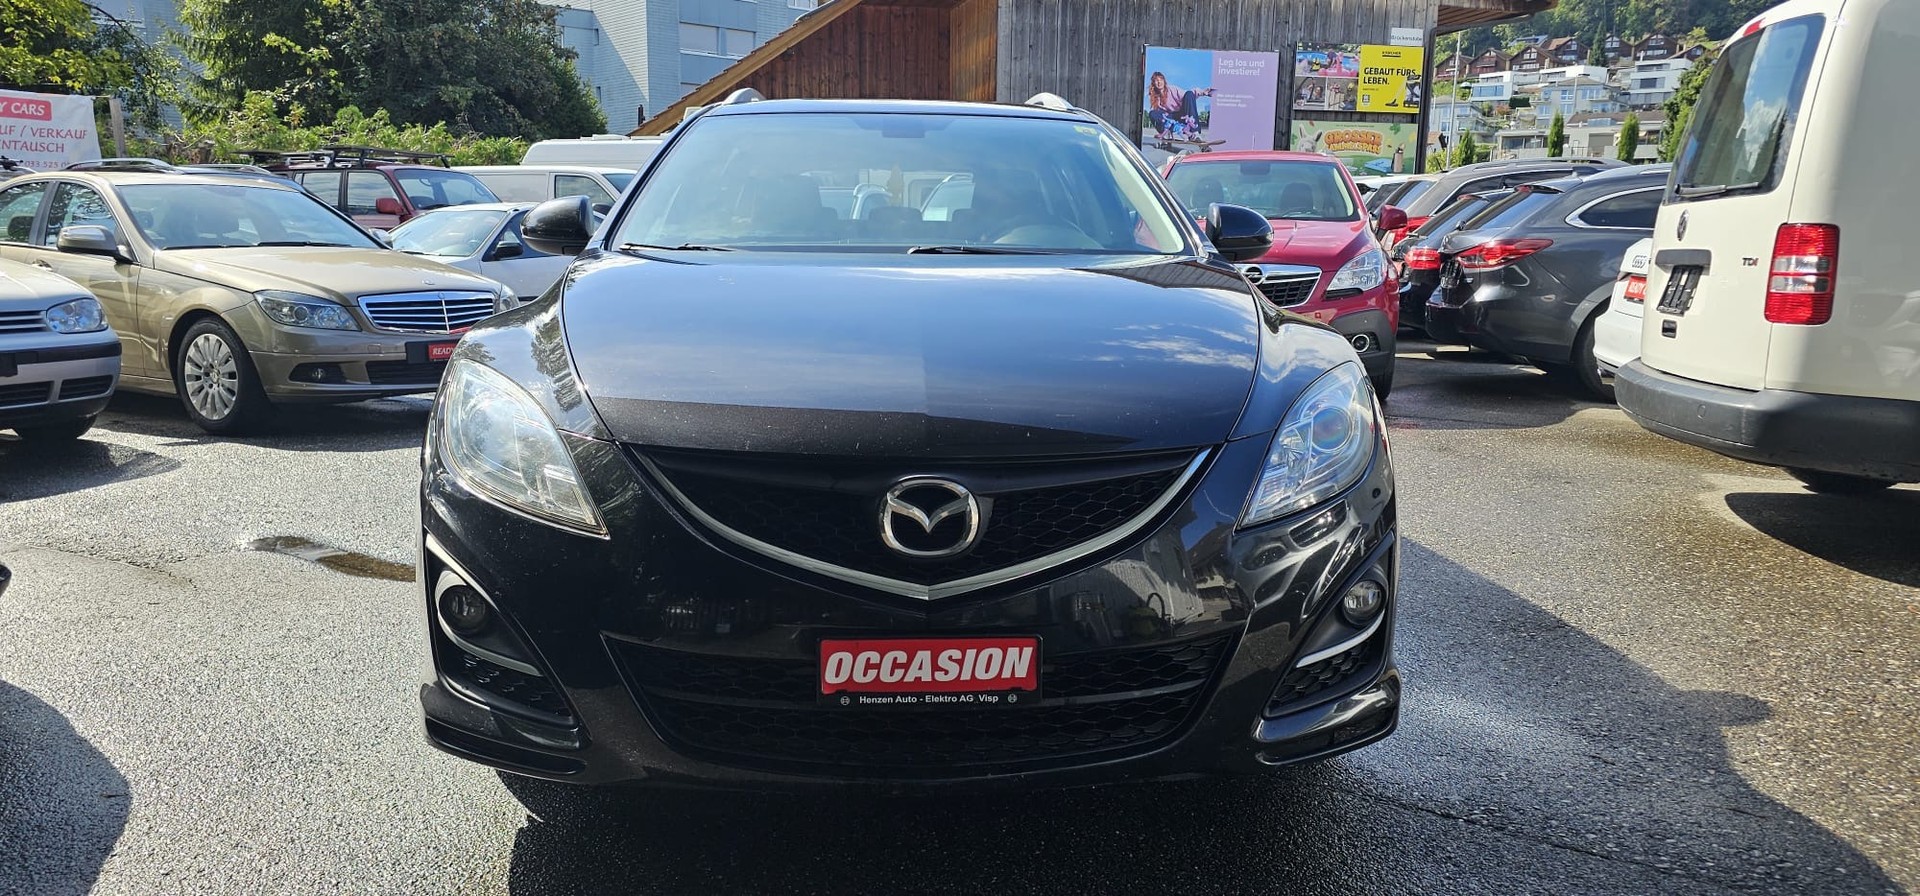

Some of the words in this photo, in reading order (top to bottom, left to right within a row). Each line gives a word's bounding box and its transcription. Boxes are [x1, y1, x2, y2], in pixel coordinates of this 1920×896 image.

[1219, 58, 1234, 67] Leg
[1235, 58, 1247, 67] los
[1218, 66, 1261, 76] investiere!
[1364, 67, 1395, 76] GEBAUT
[1363, 76, 1390, 85] LEBEN.
[11, 102, 46, 116] CARS
[20, 125, 27, 137] /
[30, 126, 88, 139] VERKAUF
[1324, 130, 1382, 146] GROSSER
[1, 140, 65, 153] NTAUSCH
[25, 160, 40, 168] 033
[43, 161, 59, 169] 525
[1742, 257, 1759, 266] TDI
[824, 647, 1033, 684] OCCASION
[859, 695, 893, 704] Henzen
[895, 695, 918, 703] Auto
[925, 694, 958, 703] Elektro
[959, 694, 974, 702] AG
[978, 694, 999, 703] Visp
